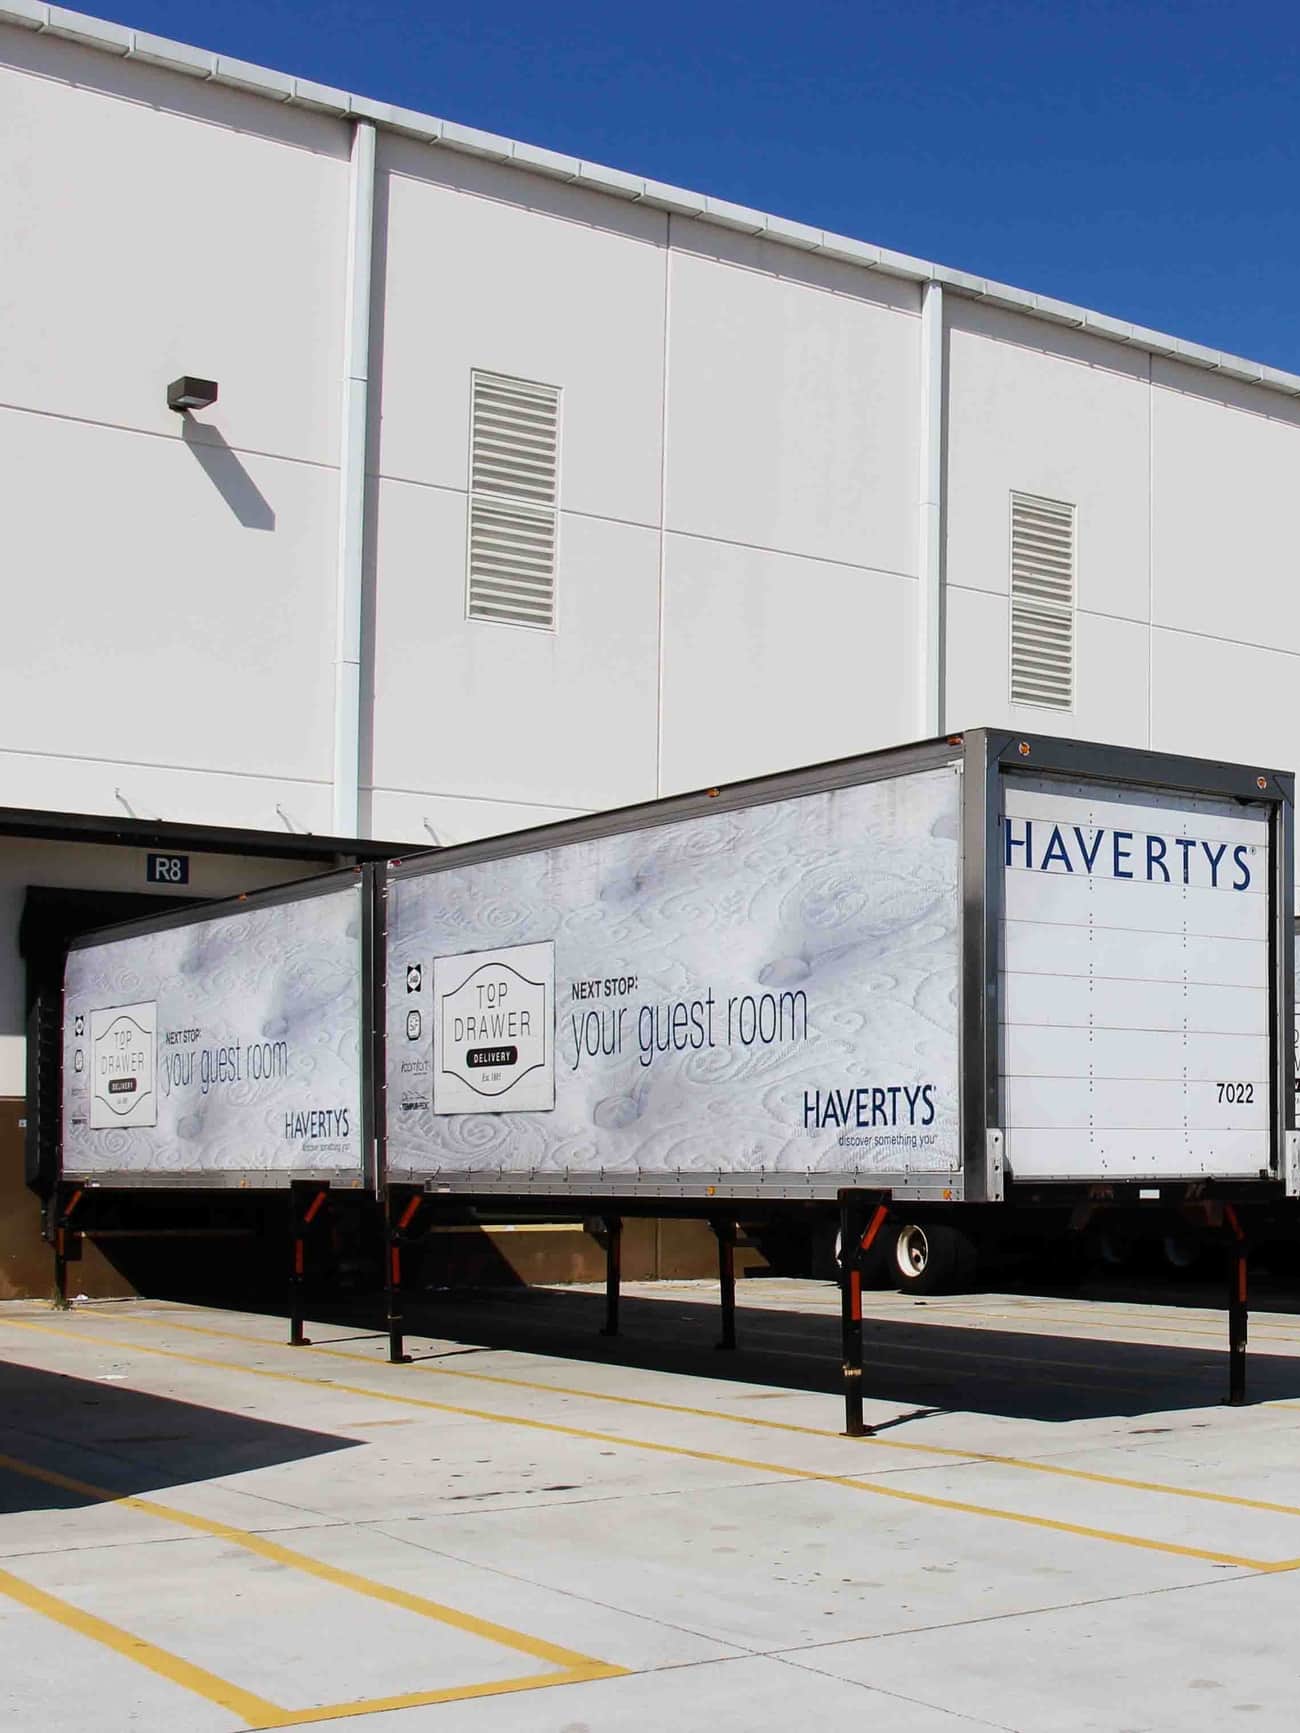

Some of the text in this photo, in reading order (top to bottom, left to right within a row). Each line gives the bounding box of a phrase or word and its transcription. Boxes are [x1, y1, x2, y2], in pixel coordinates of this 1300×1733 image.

[1005, 819, 1251, 891] HAVERTYS
[155, 857, 182, 881] R8
[475, 982, 508, 1009] TOP
[572, 976, 638, 1000] NEXT STOP:
[165, 1031, 182, 1044] NEXT
[454, 1010, 531, 1042] DRAWER
[571, 987, 807, 1070] your guest room
[114, 1031, 132, 1050] TOP
[101, 1052, 144, 1075] DRAWER
[164, 1038, 288, 1096] your guest room
[473, 1051, 512, 1064] DELIVERY
[1216, 1082, 1254, 1104] 7022
[804, 1084, 936, 1129] HAVERTYS
[284, 1107, 350, 1139] HAVERTYS
[839, 1134, 872, 1147] discover
[874, 1133, 917, 1148] something
